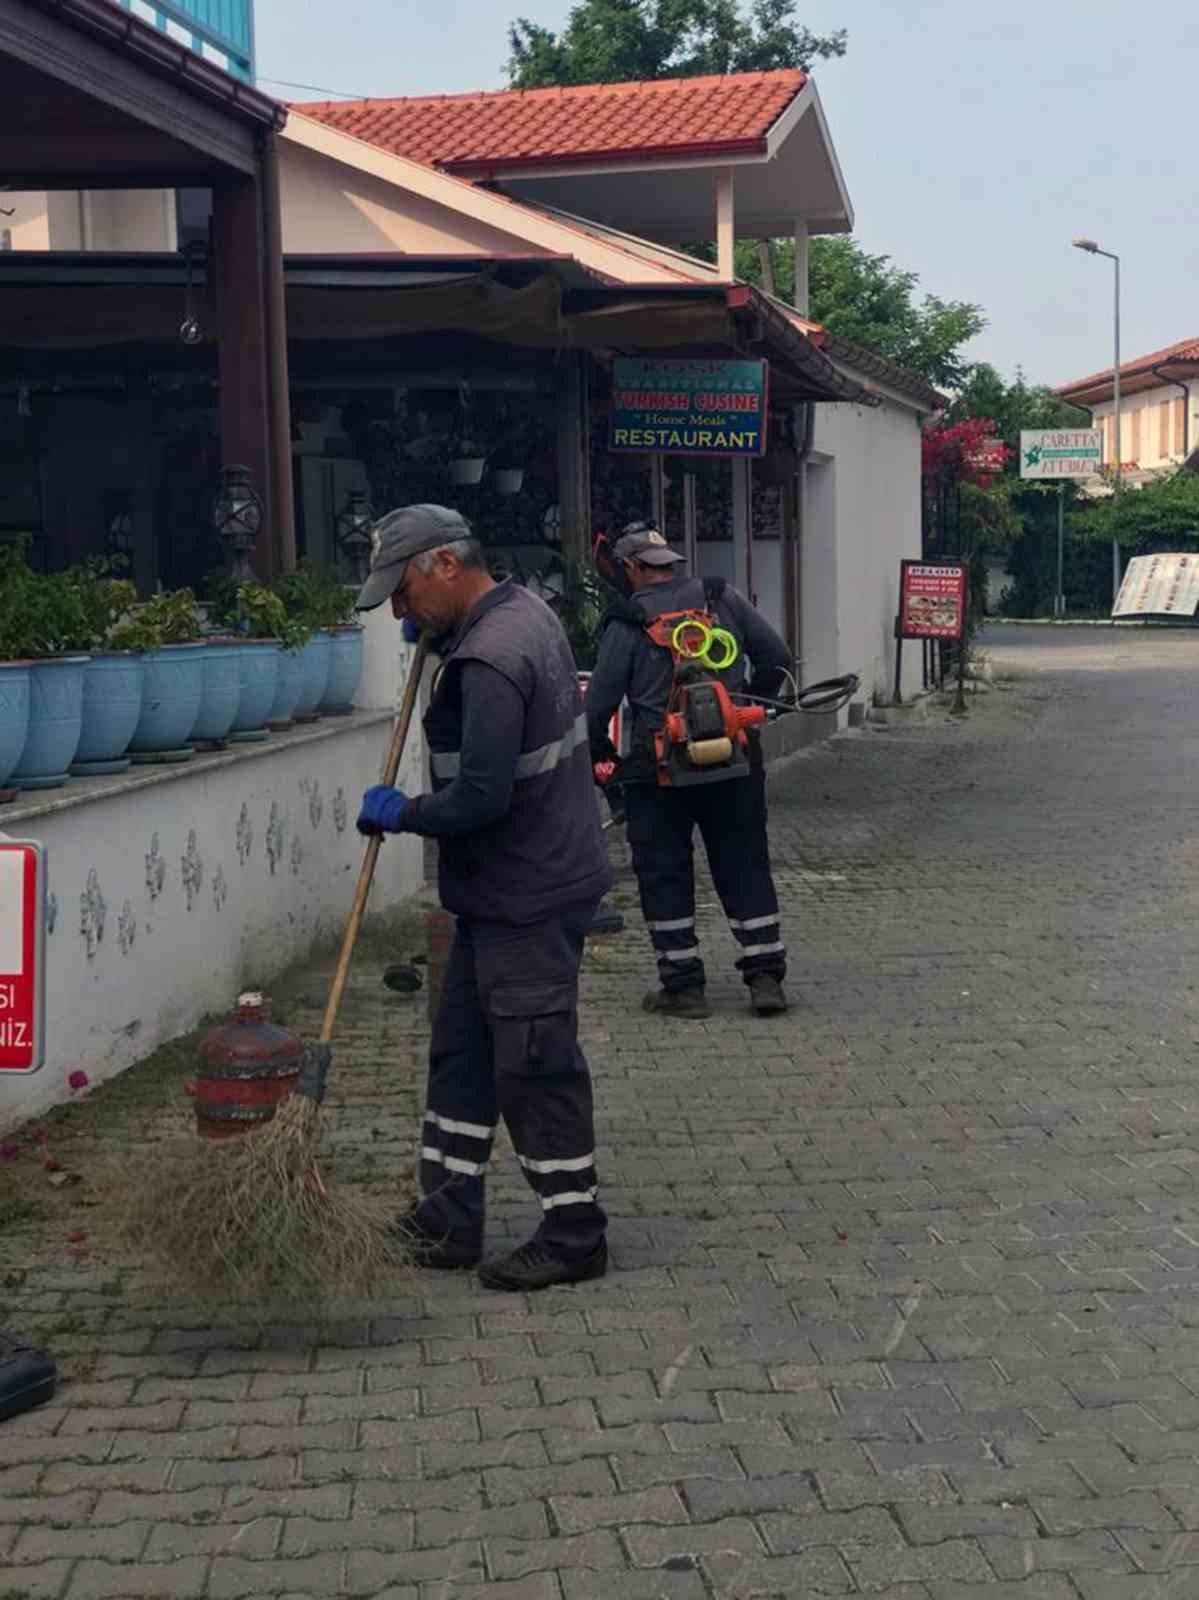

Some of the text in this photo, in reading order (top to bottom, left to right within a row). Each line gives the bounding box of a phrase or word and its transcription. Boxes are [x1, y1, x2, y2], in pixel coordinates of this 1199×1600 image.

[615, 392, 759, 413] TURKISH CUSINE
[614, 429, 758, 448] RESTAURANT
